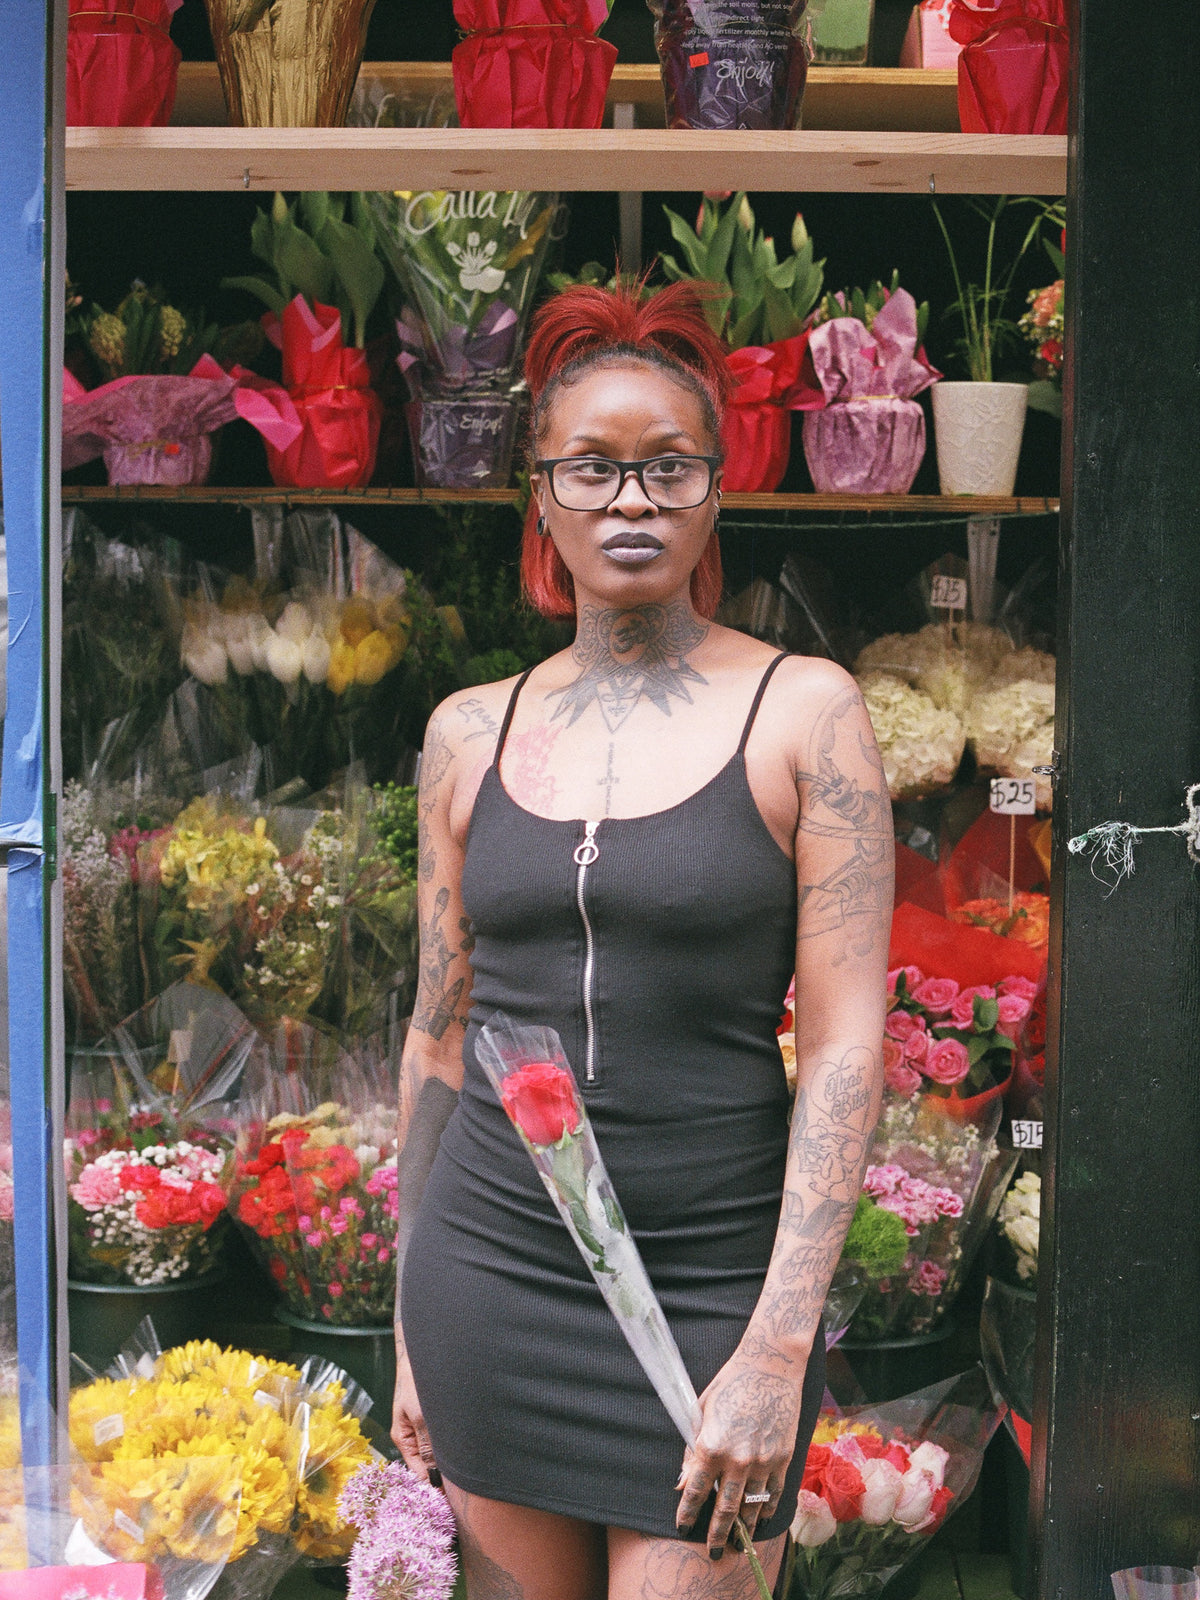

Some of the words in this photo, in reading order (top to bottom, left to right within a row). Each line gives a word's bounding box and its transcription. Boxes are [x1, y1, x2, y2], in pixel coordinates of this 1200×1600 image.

[714, 57, 775, 87] Enjoy!
[460, 412, 504, 436] Enjoy!
[990, 781, 1033, 808] $25
[825, 1064, 866, 1101] That
